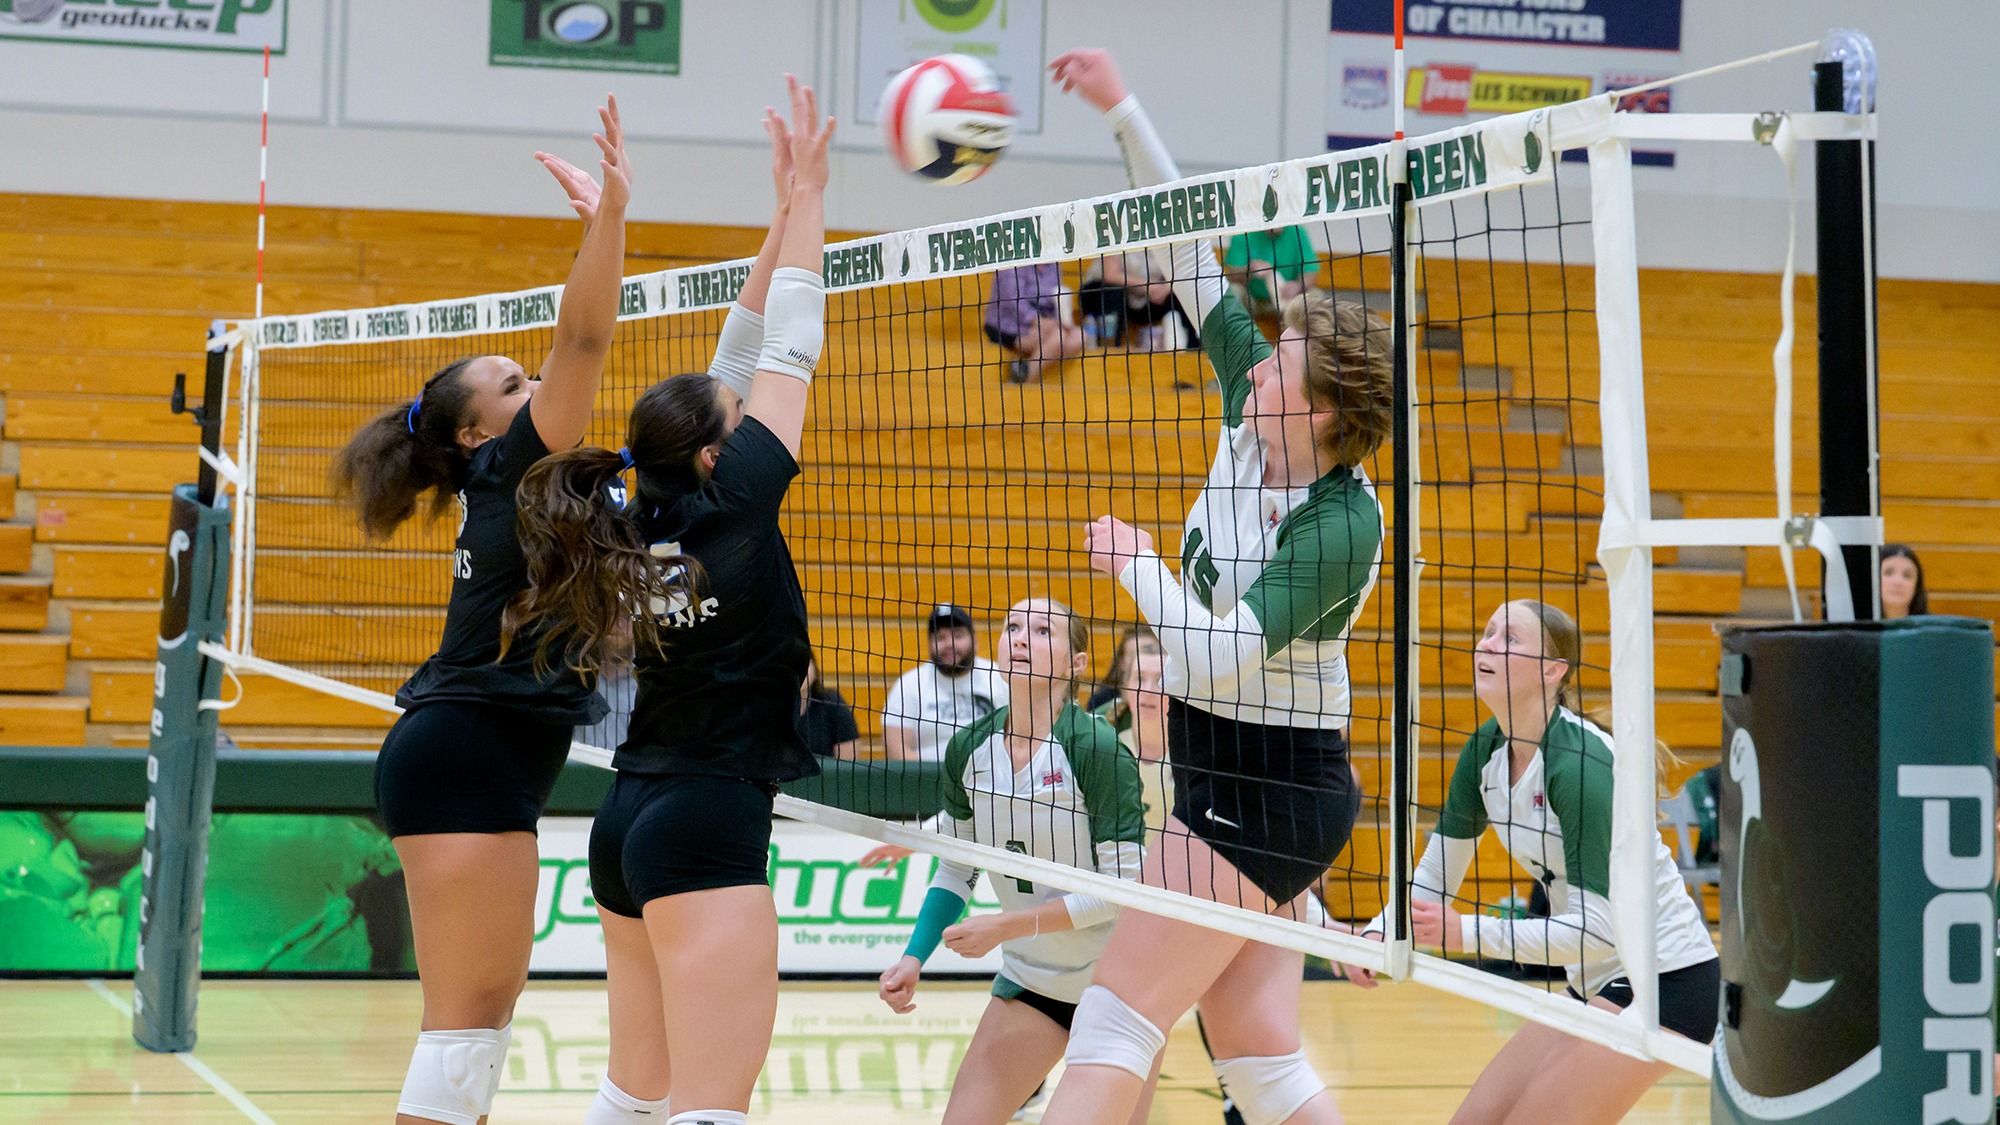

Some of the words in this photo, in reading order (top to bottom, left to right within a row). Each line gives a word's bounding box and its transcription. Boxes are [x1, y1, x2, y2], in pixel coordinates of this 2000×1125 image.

[61, 9, 210, 31] geoducks
[1407, 5, 1445, 32] OF
[1448, 6, 1606, 41] CHARACTER
[1474, 82, 1502, 101] LES
[1303, 130, 1487, 216] EVERREEN
[1093, 179, 1236, 248] EVERGREEN
[928, 215, 1042, 273] EVERGREEN
[678, 264, 755, 308] EVERGREE
[794, 929, 821, 944] the
